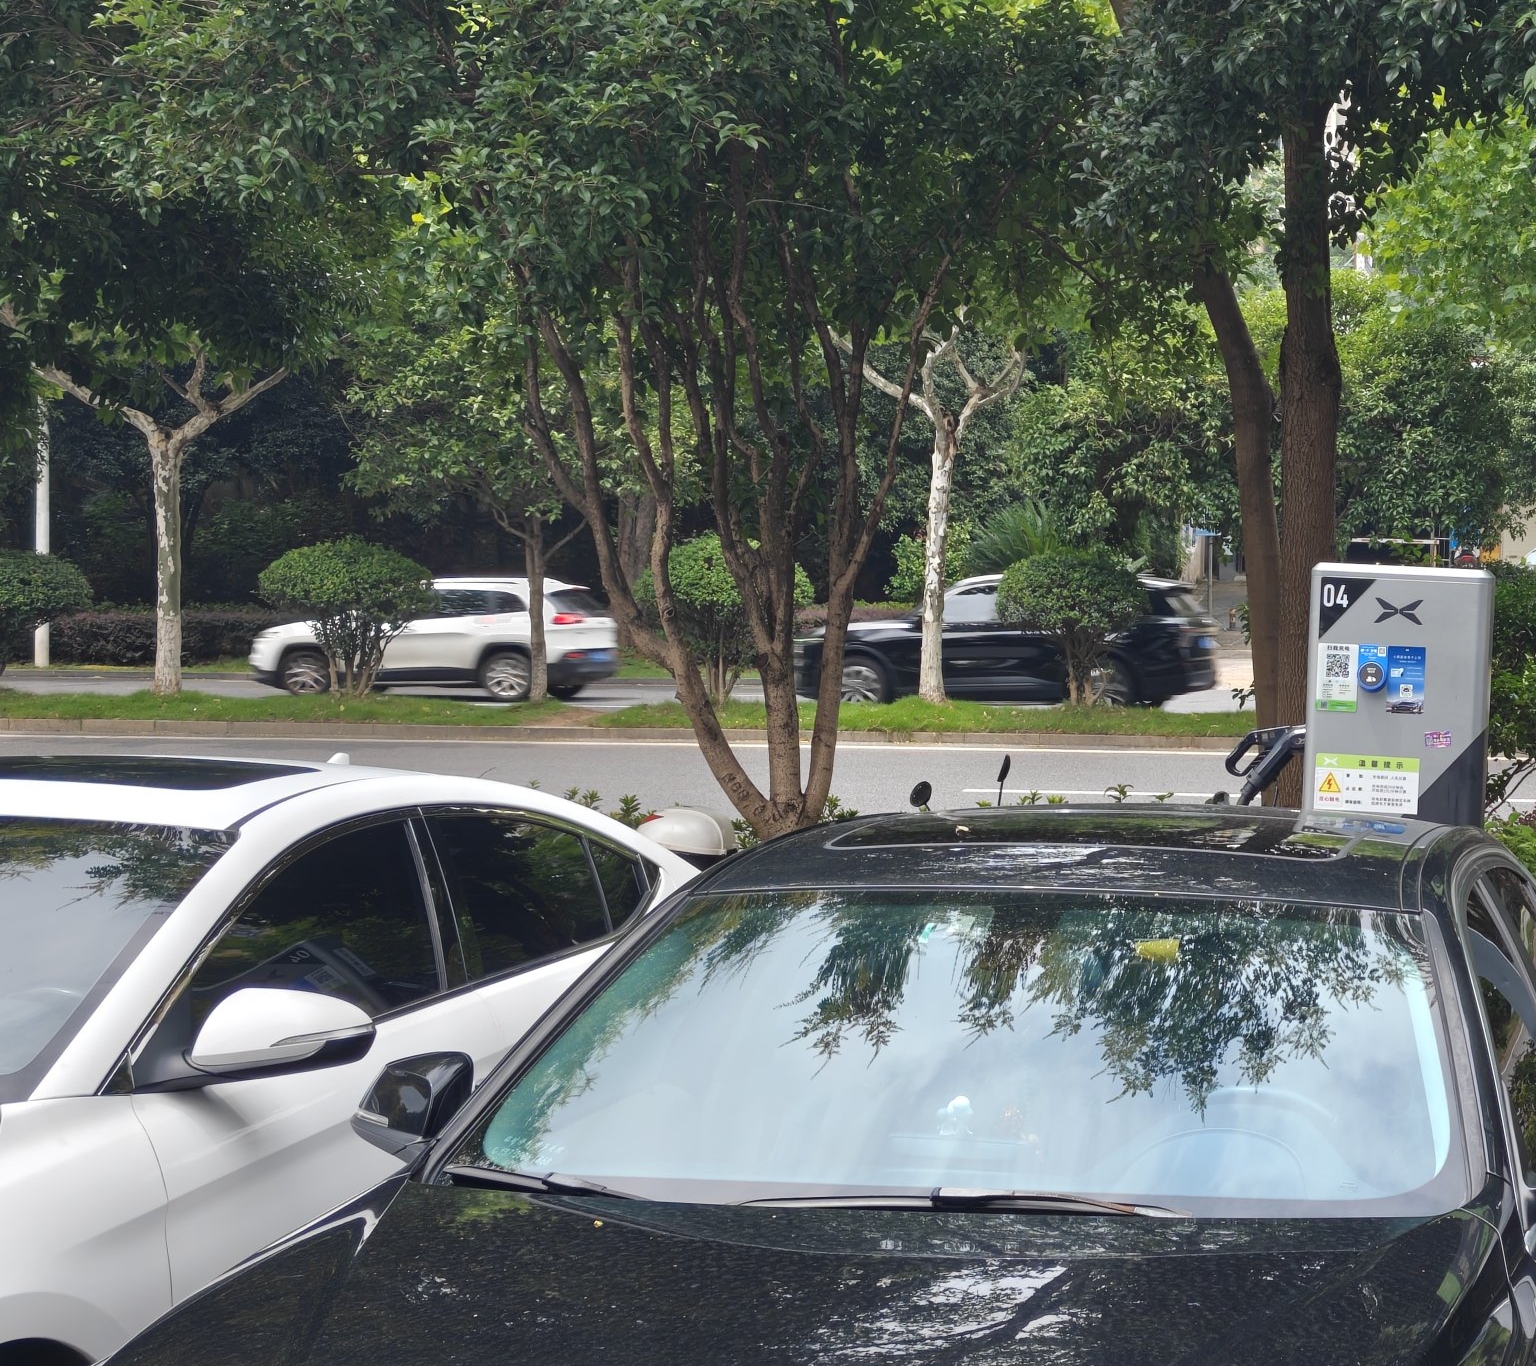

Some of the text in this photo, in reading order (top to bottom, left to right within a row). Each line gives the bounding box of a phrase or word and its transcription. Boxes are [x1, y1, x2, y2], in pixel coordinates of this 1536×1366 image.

[1323, 584, 1349, 608] 04
[1358, 759, 1404, 769] 温馨提示
